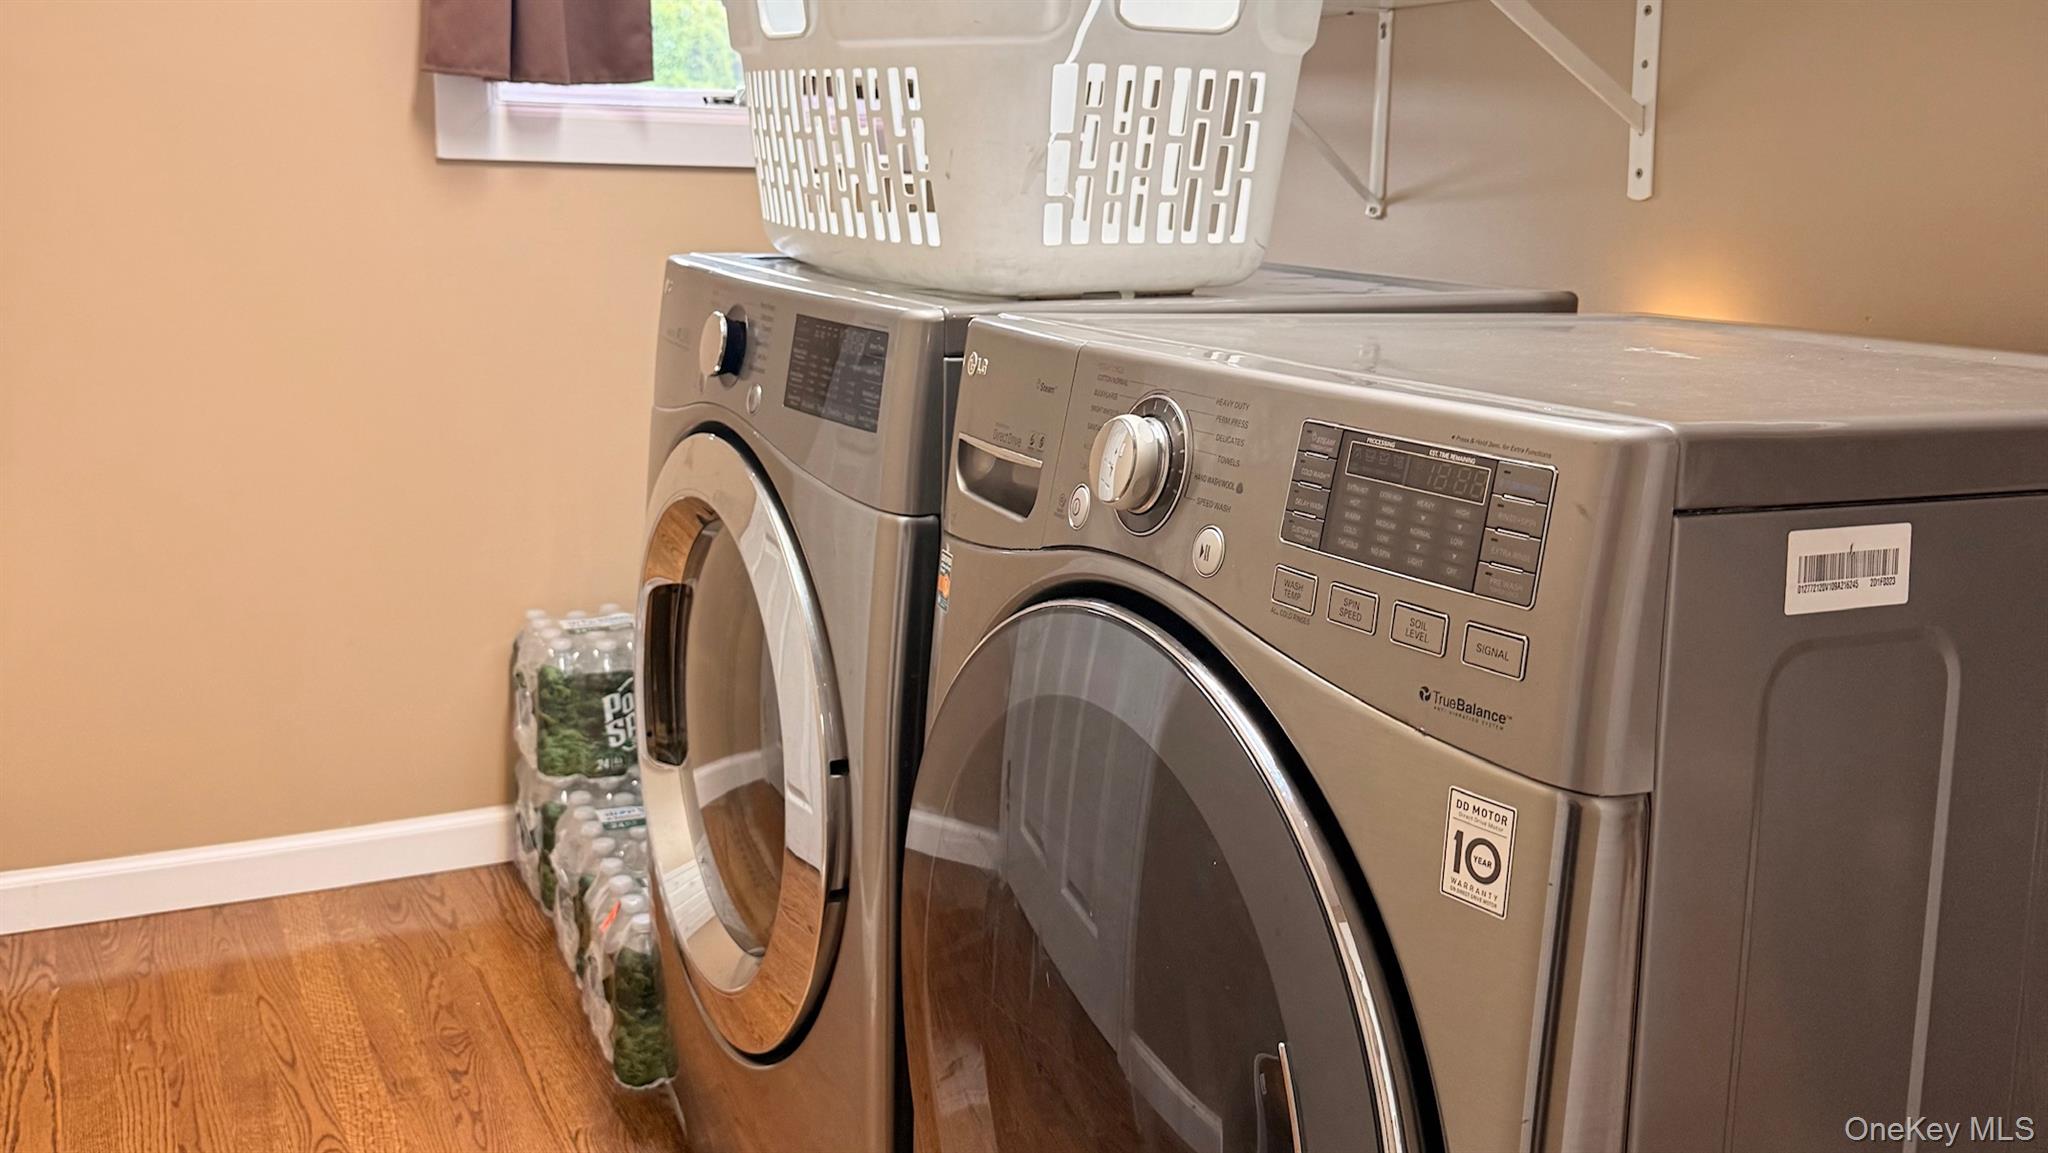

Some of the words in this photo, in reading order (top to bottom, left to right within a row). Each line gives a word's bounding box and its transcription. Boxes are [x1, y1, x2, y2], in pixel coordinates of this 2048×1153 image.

[1216, 398, 1234, 408] HEAVY
[1235, 400, 1250, 412] DUTY
[1216, 433, 1245, 448] DELICATES
[1366, 437, 1396, 448] PROCESSING
[1216, 454, 1240, 468] TOWELS
[1440, 451, 1450, 460] TIME
[1450, 453, 1476, 464] REMAINING
[1196, 496, 1214, 508] SPEED
[1214, 502, 1232, 513] WASH
[1284, 579, 1304, 591] WASH
[1284, 590, 1300, 600] TEMP
[1344, 598, 1360, 610] SPIN
[1338, 608, 1362, 622] SPEED
[1410, 618, 1428, 632] SOIL
[1405, 628, 1429, 644] LEVEL
[1476, 642, 1509, 662] SIGNAL
[1456, 799, 1470, 812] DD
[1472, 804, 1508, 826] MOTOR
[1454, 830, 1502, 885] 10
[1474, 856, 1492, 868] YEAR
[1450, 877, 1498, 900] WARRANTY
